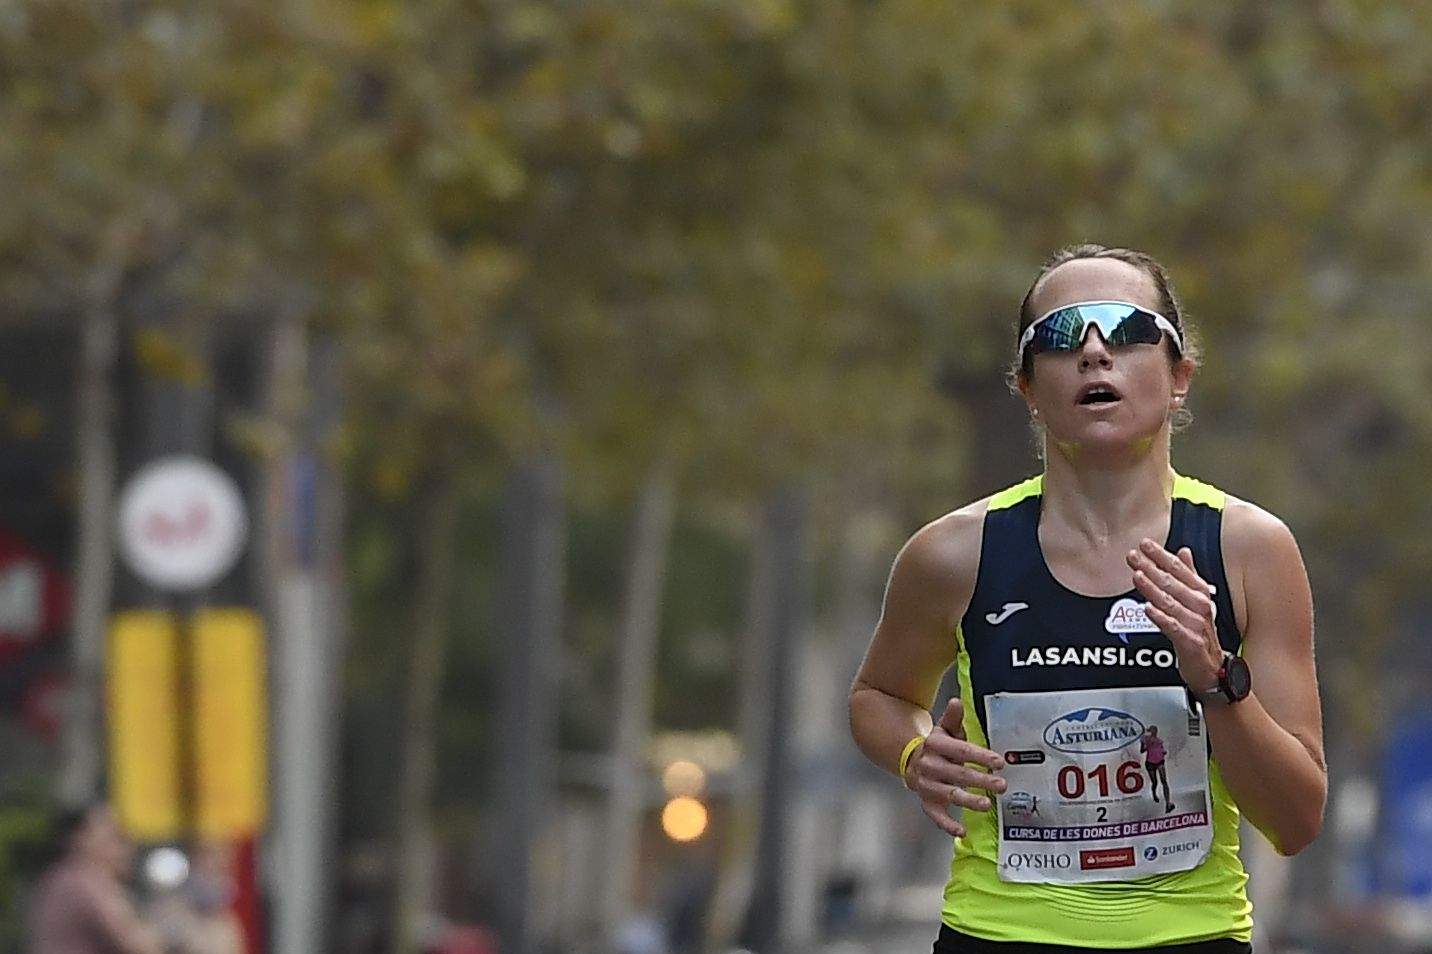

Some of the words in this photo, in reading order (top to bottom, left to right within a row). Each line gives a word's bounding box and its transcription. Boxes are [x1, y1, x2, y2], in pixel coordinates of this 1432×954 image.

[1011, 646, 1179, 669] LASANSI.CO
[1052, 727, 1138, 746] ASTURIANA
[1057, 760, 1145, 800] 016
[1096, 806, 1109, 823] 2
[1008, 827, 1042, 840] CURSA
[1043, 828, 1057, 840] DE
[1059, 828, 1080, 840] LES
[1082, 824, 1121, 839] DONES
[1123, 822, 1138, 835] DE
[1140, 813, 1206, 833] BARCELONA
[1162, 841, 1200, 856] ZURICH
[1007, 852, 1072, 869] OYSHO
